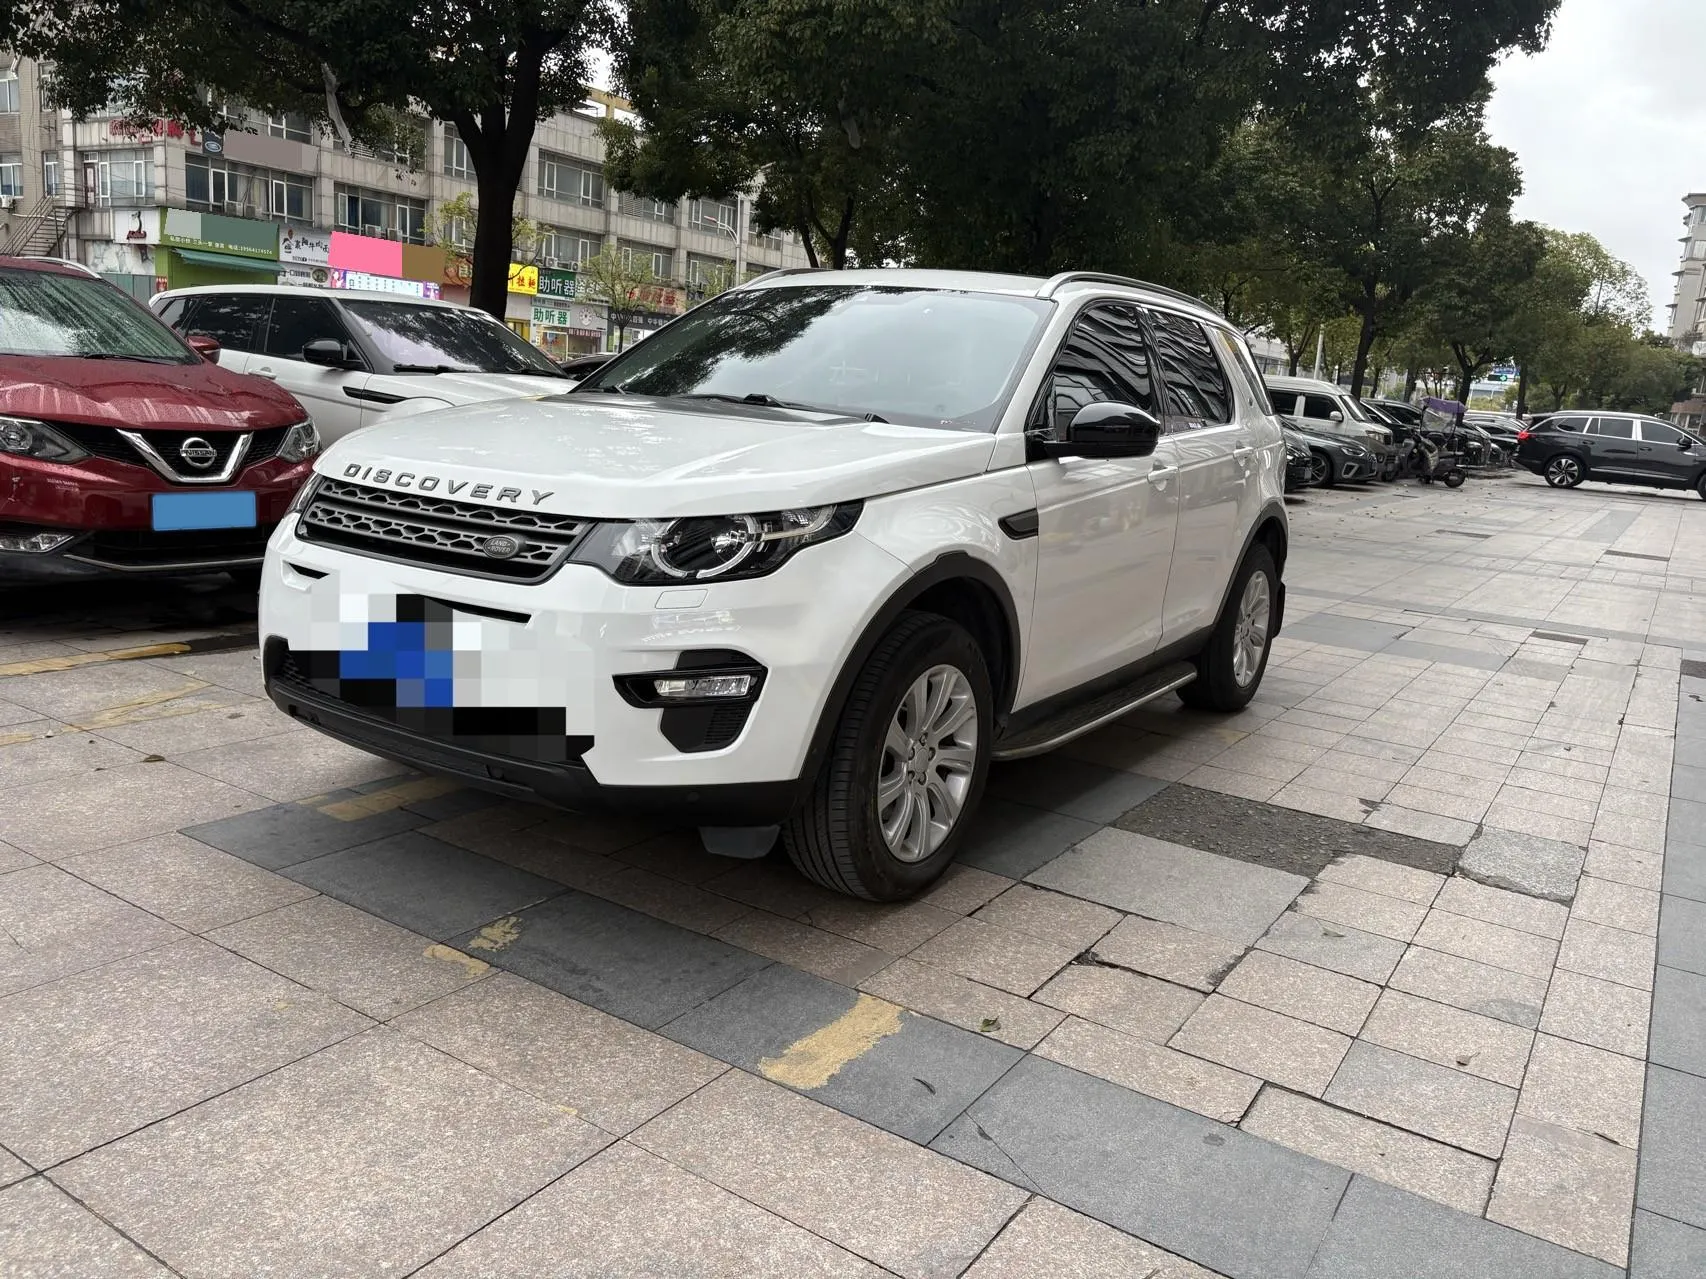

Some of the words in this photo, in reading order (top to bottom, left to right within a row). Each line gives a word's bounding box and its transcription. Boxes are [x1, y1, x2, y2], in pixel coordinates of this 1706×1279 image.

[539, 276, 575, 297] 助听器
[534, 308, 568, 325] 助听器
[343, 463, 555, 506] DISCOVERY
[490, 539, 508, 547] LAND
